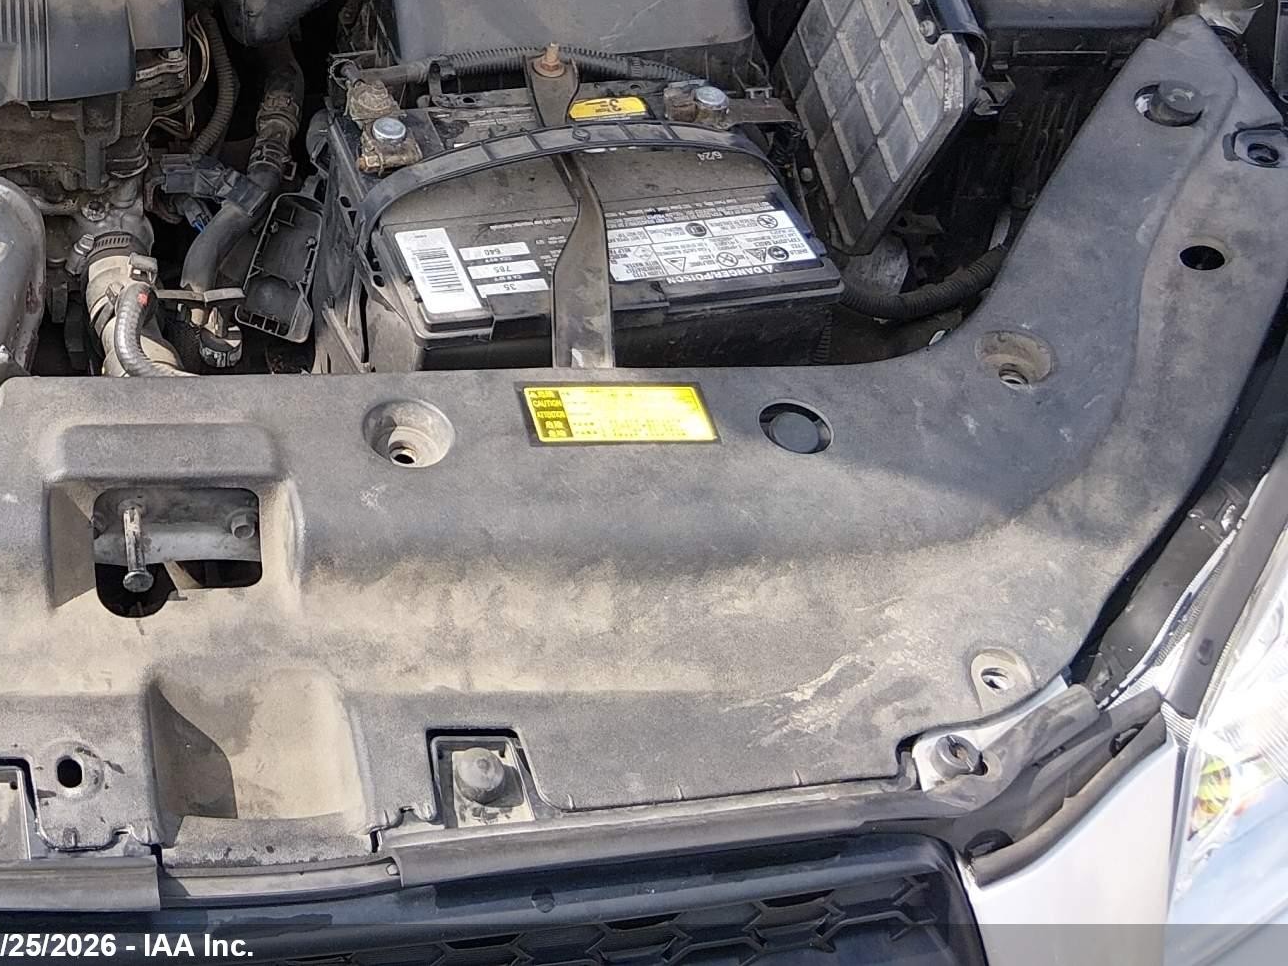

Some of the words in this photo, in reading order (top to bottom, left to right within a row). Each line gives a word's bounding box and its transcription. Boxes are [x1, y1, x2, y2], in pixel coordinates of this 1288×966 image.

[696, 150, 723, 162] 6/24
[483, 248, 502, 256] 640
[493, 265, 512, 274] 785
[503, 283, 518, 291] 35
